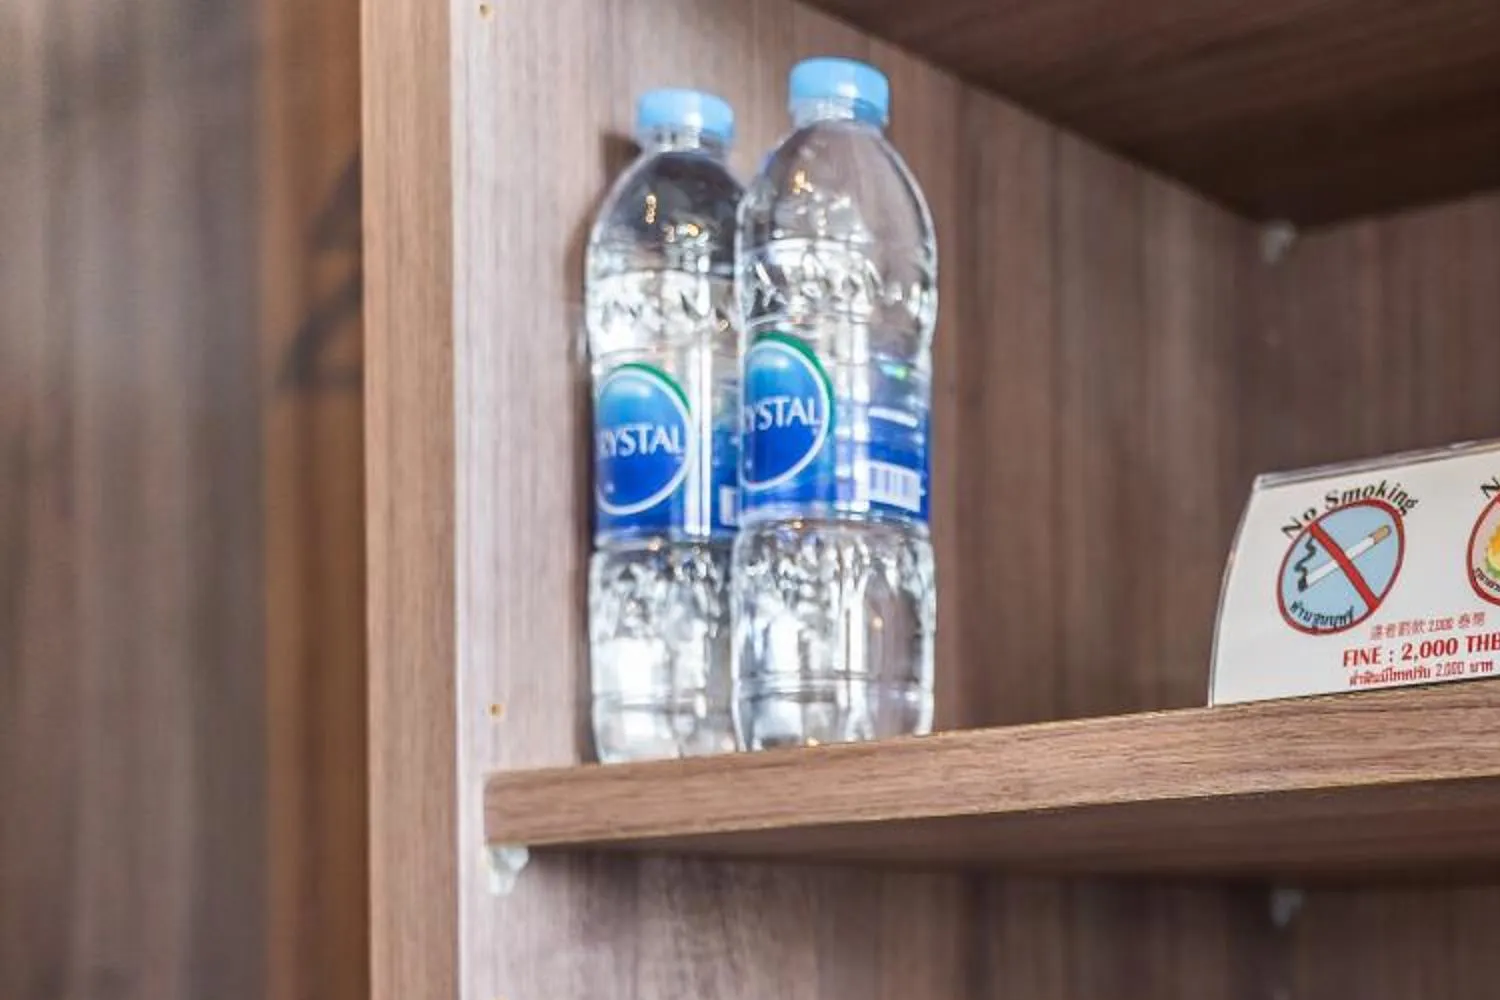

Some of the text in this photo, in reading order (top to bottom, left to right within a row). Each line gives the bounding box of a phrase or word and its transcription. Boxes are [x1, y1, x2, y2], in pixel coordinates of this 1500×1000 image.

[744, 396, 823, 431] YSTAL
[1281, 479, 1419, 540] No Smoking
[1343, 647, 1382, 667] FINE
[1401, 638, 1459, 663] 2,000
